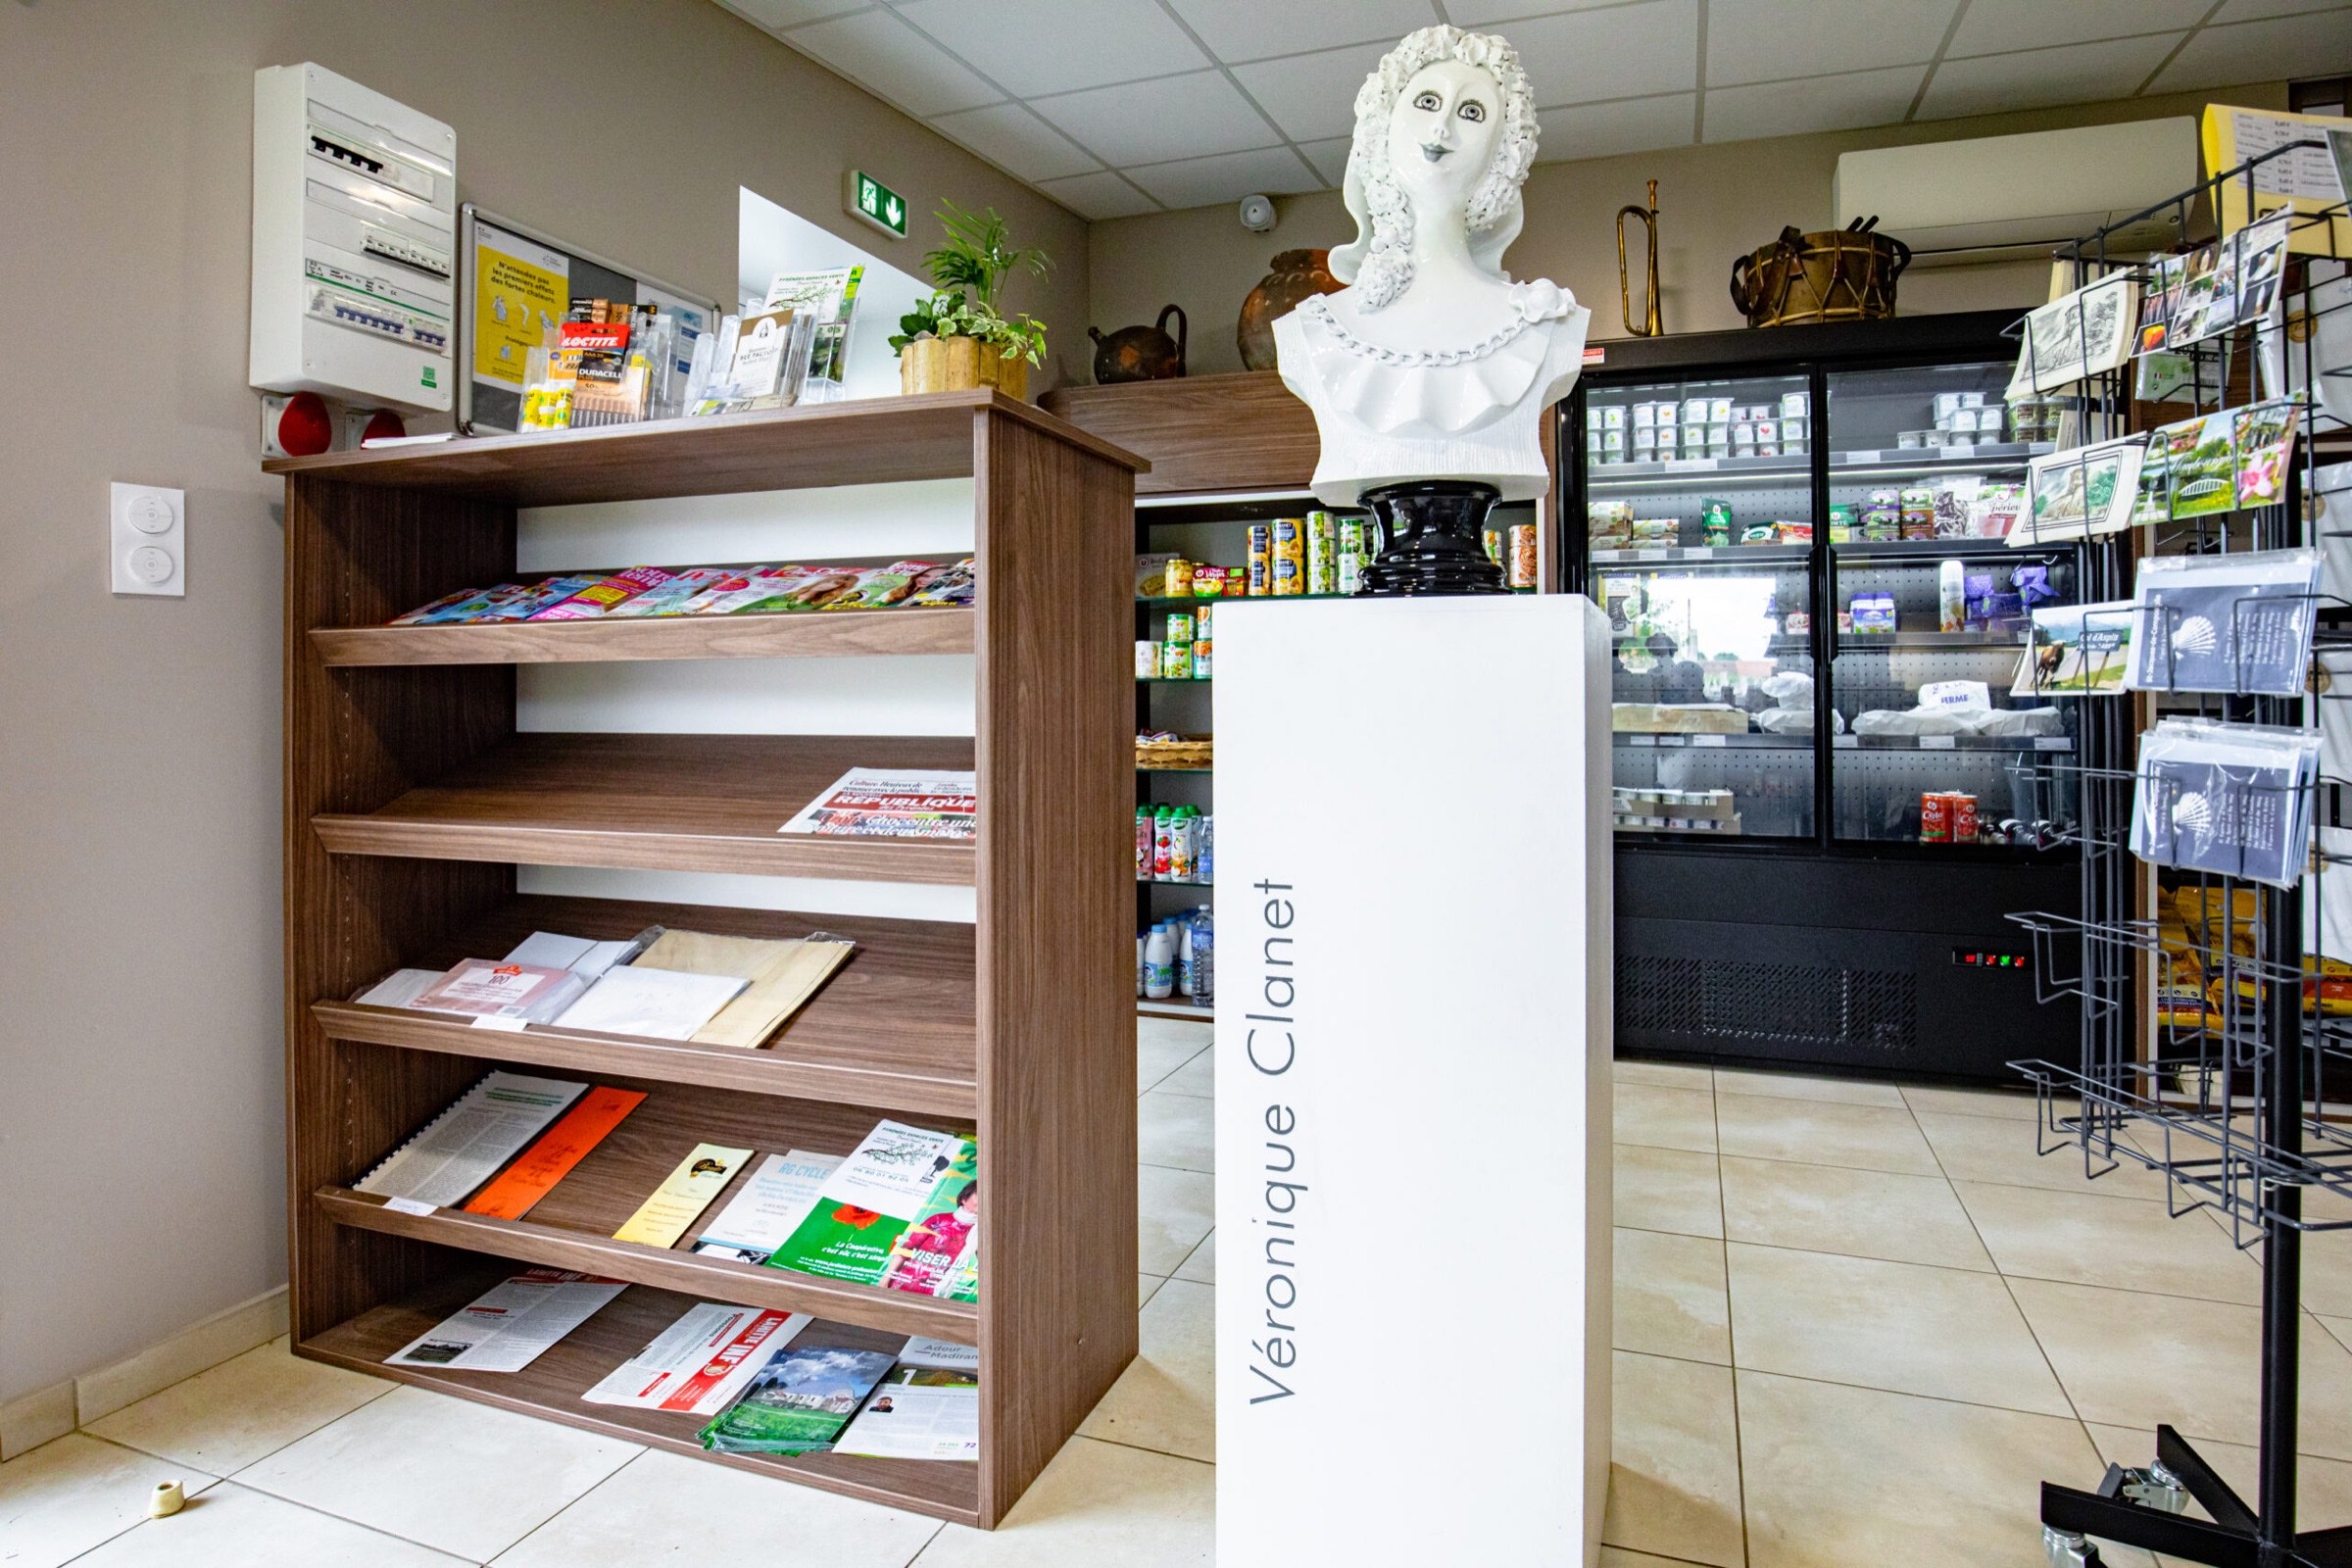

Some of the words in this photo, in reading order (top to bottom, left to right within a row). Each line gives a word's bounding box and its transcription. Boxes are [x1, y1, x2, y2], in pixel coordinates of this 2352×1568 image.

[561, 336, 618, 347] LOCTITE
[1245, 877, 1296, 1076] Clanet
[868, 1253, 888, 1262] simp
[910, 1248, 952, 1267] VISER
[1250, 1102, 1308, 1404] Véronique
